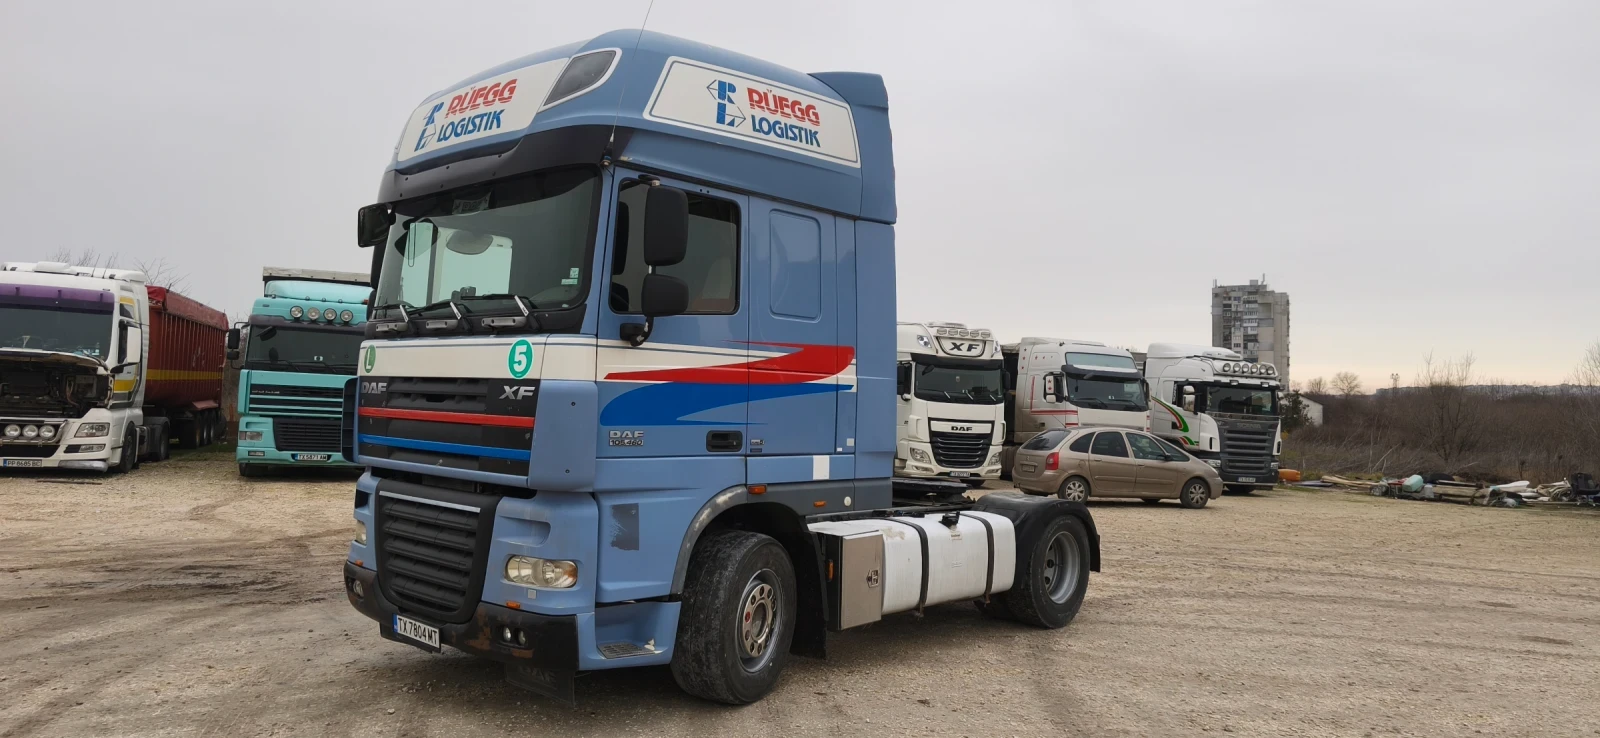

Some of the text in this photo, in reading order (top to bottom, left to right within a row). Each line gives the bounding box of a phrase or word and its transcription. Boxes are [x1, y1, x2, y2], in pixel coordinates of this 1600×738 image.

[444, 78, 518, 119] RÜEGG
[746, 86, 821, 127] RÜEGG
[436, 108, 506, 143] LOGISTIK
[751, 114, 821, 148] LOGISTIK
[949, 341, 980, 352] XF
[365, 348, 372, 370] L
[513, 344, 528, 372] 5
[360, 381, 388, 394] DAF
[498, 385, 536, 400] XF
[609, 430, 645, 438] DAF
[398, 617, 408, 634] TX
